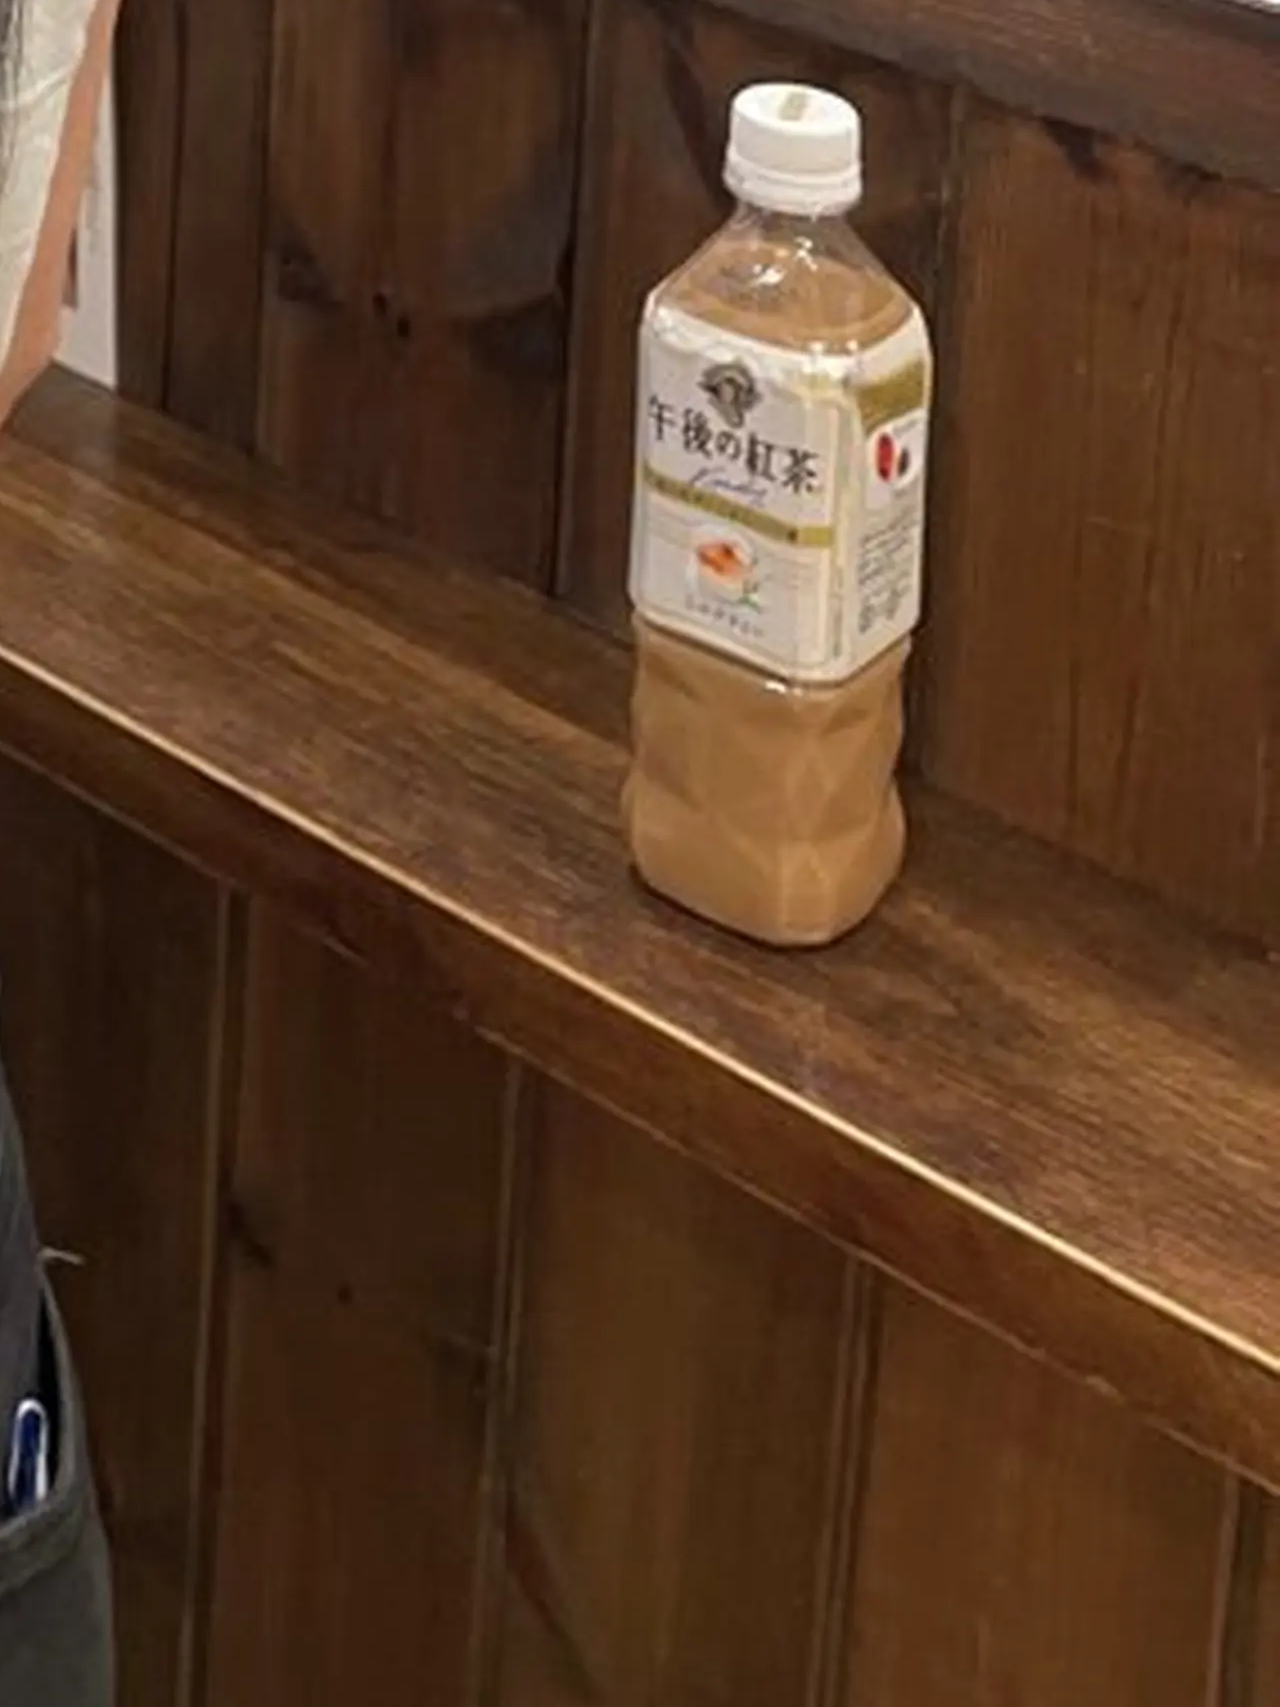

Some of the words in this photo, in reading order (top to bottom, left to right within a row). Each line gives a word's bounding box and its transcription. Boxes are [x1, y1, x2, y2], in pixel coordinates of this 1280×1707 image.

[648, 395, 821, 494] 午後の紅茶
